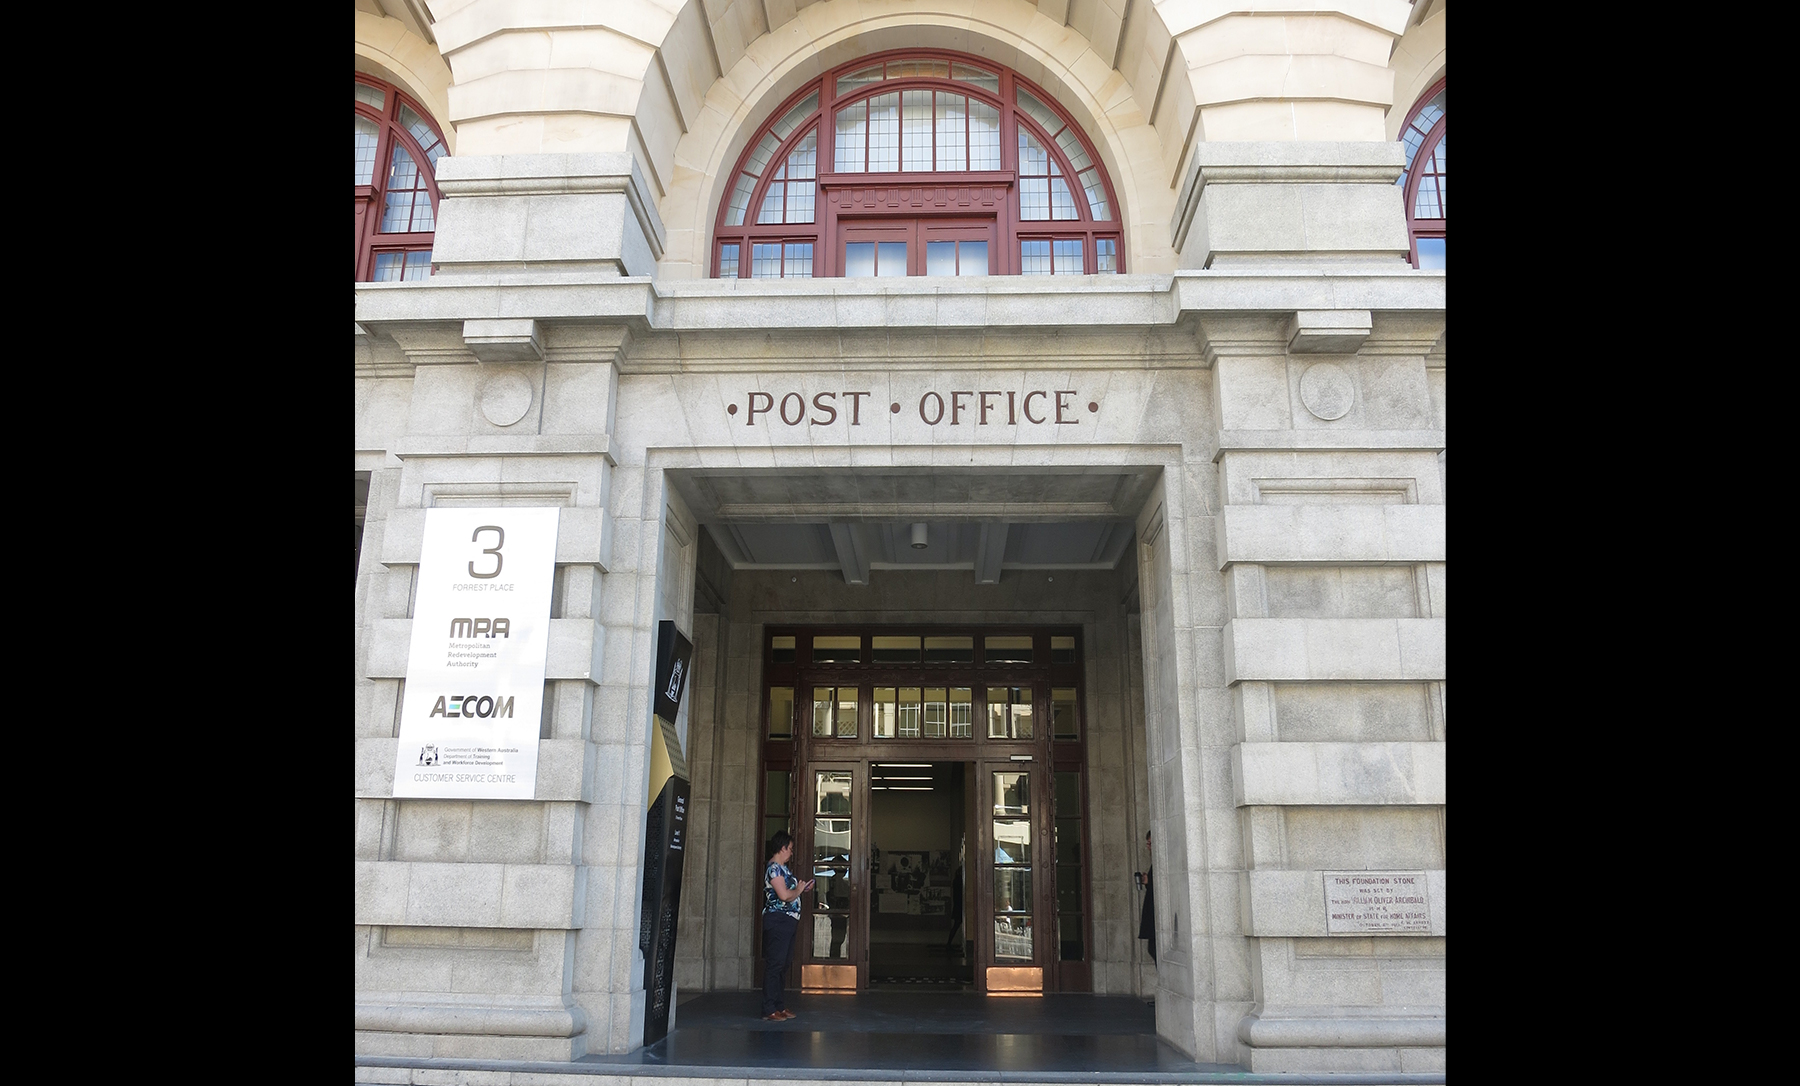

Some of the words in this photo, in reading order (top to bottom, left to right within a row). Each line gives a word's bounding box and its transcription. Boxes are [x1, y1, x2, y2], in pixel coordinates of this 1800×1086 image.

[746, 391, 871, 426] POST
[918, 390, 1080, 426] OFFICE
[468, 525, 505, 579] 3
[452, 583, 488, 592] FORREST
[489, 583, 515, 592] PLACE
[449, 617, 511, 639] MRA
[448, 642, 491, 650] Metropolitan
[447, 651, 497, 659] Redevelopment
[446, 660, 479, 668] Authority
[429, 695, 515, 719] AECOM
[413, 773, 454, 783] CUSTOMER
[455, 773, 485, 783] SERVICE
[486, 774, 516, 784] CENTRE
[1335, 877, 1350, 885] THIS
[1352, 877, 1390, 885] FOUNDATION
[1393, 877, 1415, 885] STONE
